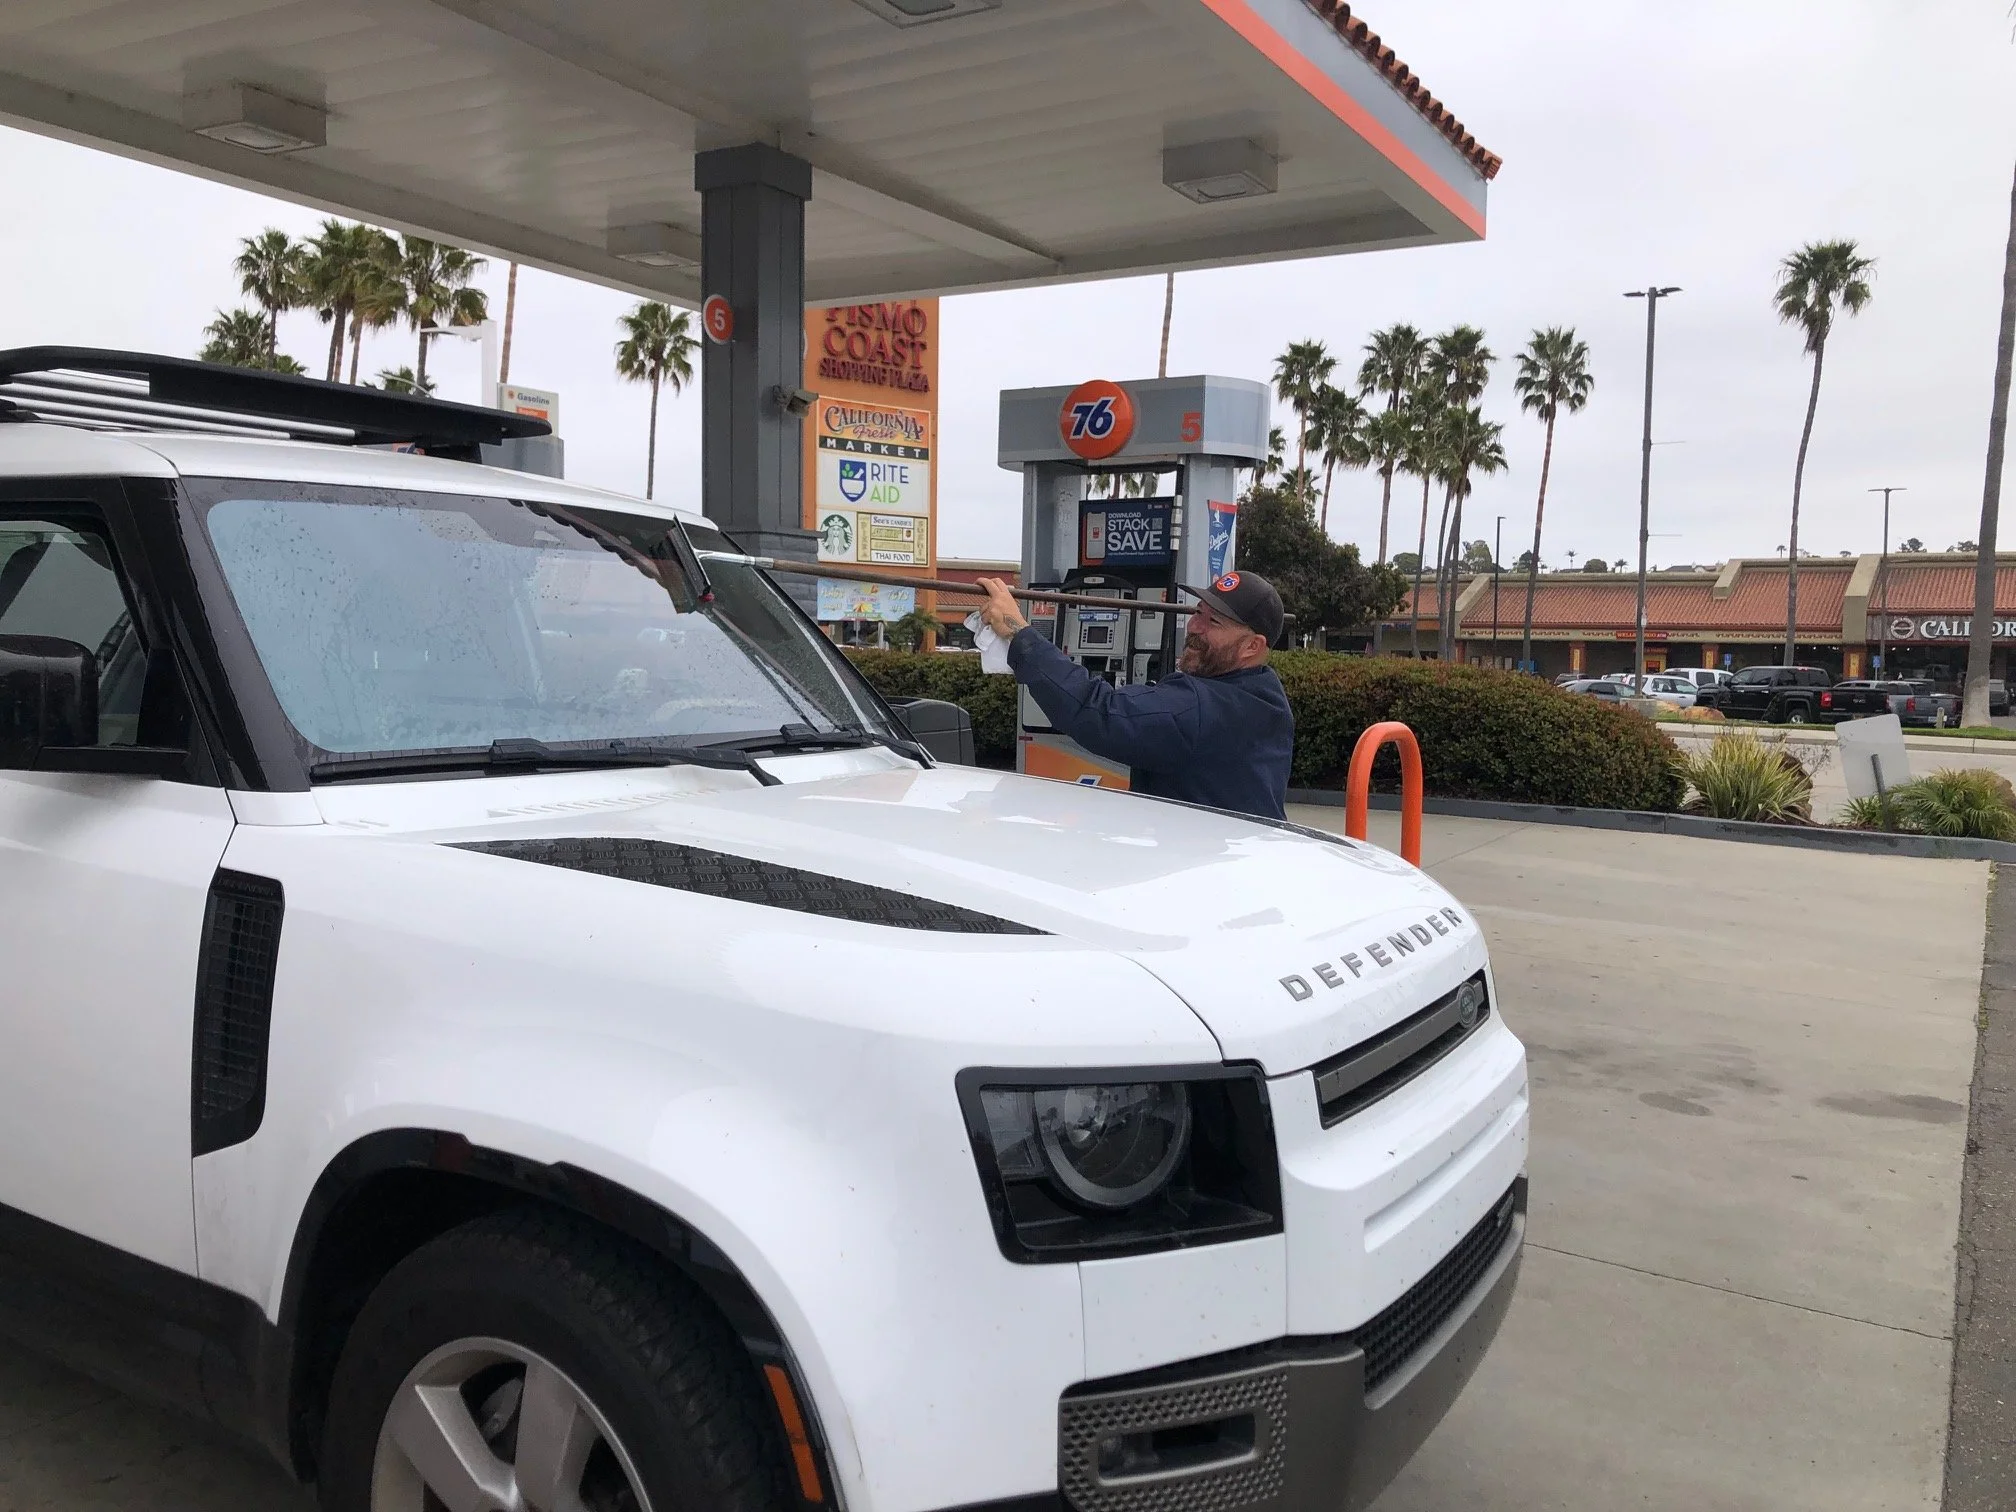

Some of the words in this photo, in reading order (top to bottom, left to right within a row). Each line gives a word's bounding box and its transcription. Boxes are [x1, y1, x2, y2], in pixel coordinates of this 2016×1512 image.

[714, 308, 726, 331] 5
[824, 325, 928, 369] COAST
[819, 357, 887, 386] SHOPPING
[888, 367, 931, 393] PLAZA
[517, 392, 550, 406] Gasoline
[825, 405, 924, 441] CALIFORNIA
[1069, 397, 1117, 440] 76
[1181, 412, 1203, 443] 5
[853, 424, 895, 439] Fresh
[826, 438, 922, 459] MARKET
[871, 462, 910, 485] RITE
[870, 485, 901, 504] AID
[1108, 518, 1150, 531] STACK
[1108, 530, 1163, 551] SAVE
[875, 552, 892, 561] THAI
[893, 553, 911, 562] FOOD
[1920, 619, 2016, 640] CALIOR
[1279, 906, 1463, 1002] DEFENDER
